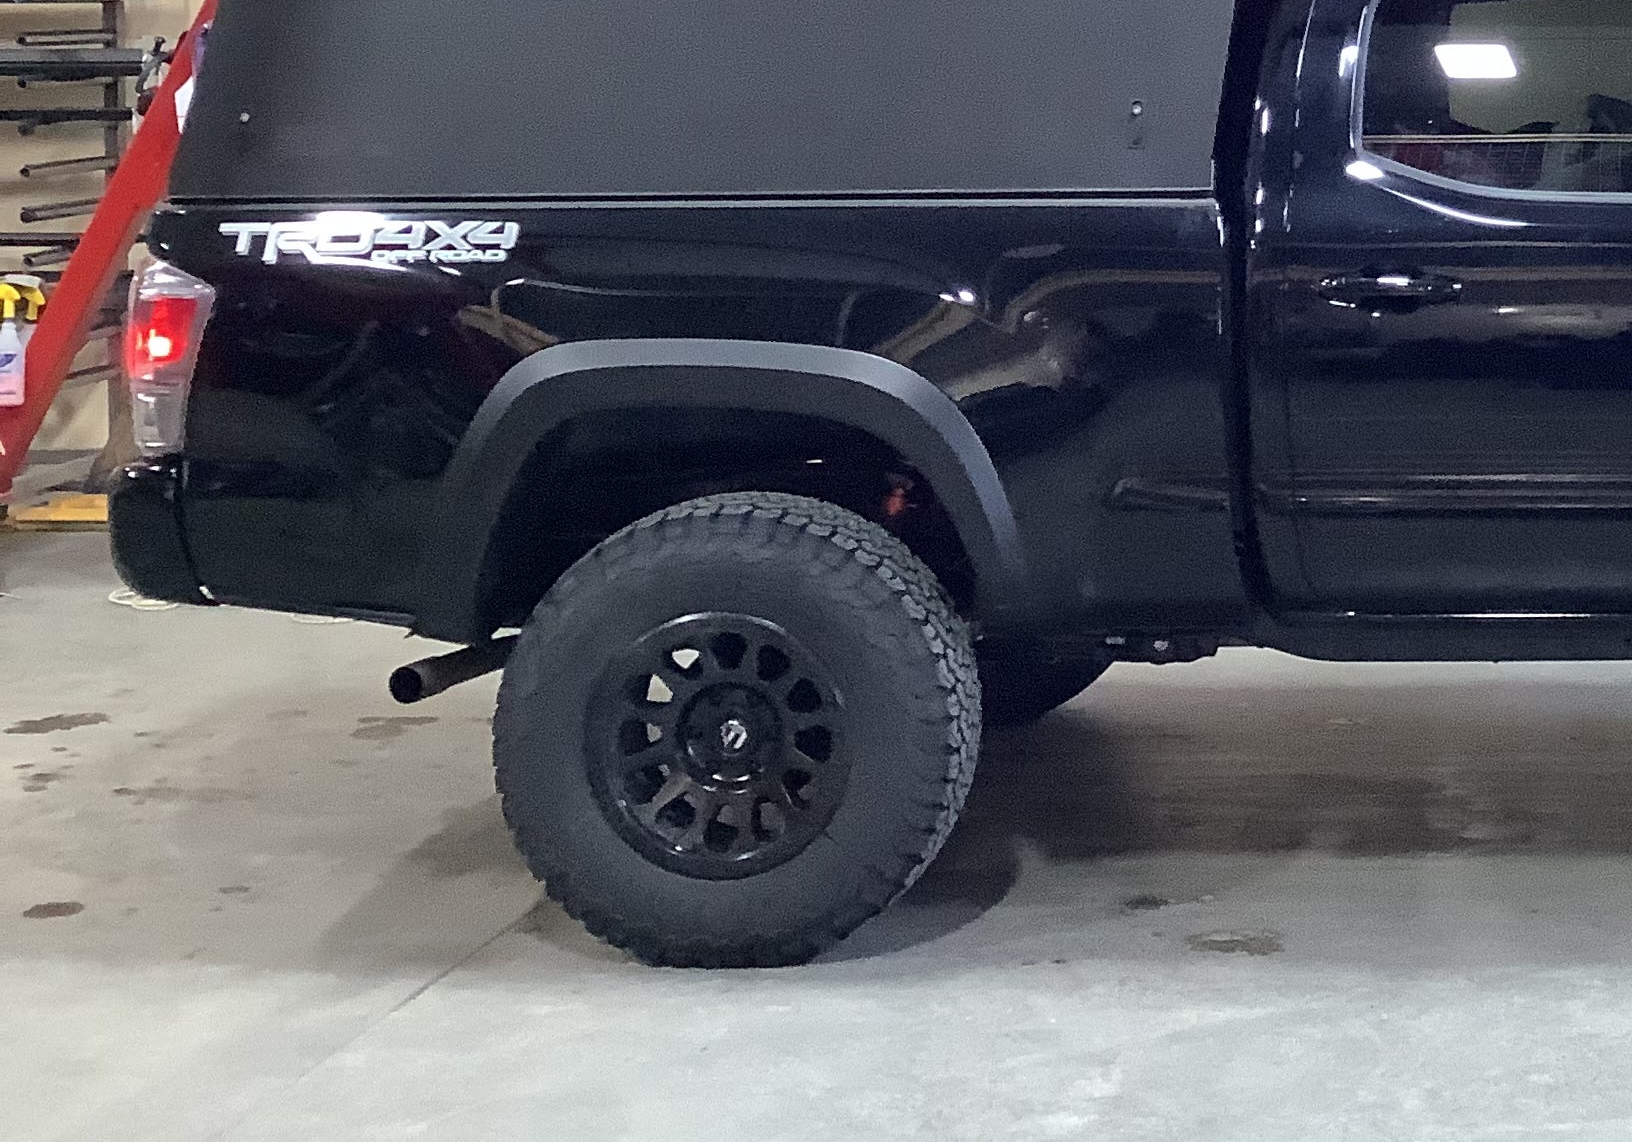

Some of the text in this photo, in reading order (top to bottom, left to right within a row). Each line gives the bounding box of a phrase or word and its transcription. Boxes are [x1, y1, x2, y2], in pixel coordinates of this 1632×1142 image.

[218, 211, 382, 266] TRD
[371, 249, 508, 264] OFF ROAD
